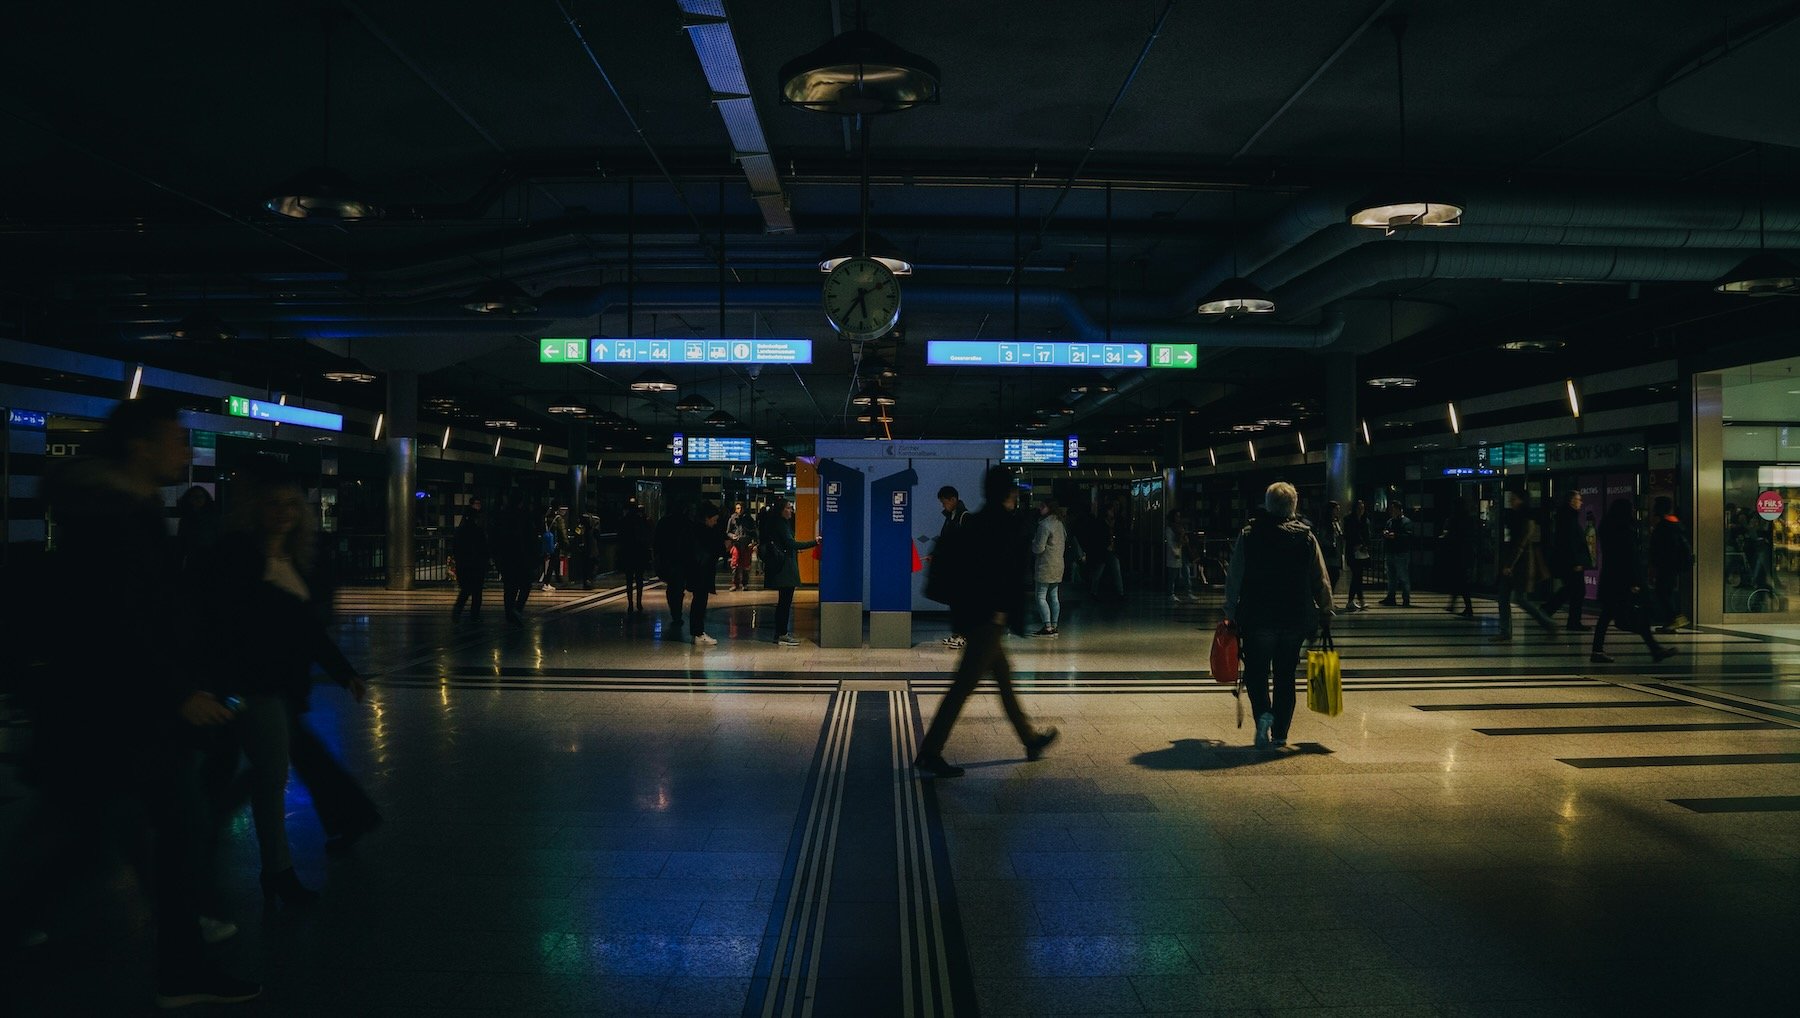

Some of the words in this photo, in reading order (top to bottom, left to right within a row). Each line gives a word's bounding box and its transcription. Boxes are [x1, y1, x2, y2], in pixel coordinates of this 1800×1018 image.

[618, 347, 631, 358] 41
[652, 347, 667, 358] 44
[1005, 350, 1013, 361] 3
[1038, 351, 1050, 362] 17
[1072, 351, 1085, 362] 21
[1106, 352, 1121, 363] 34
[1593, 443, 1622, 459] SHOP
